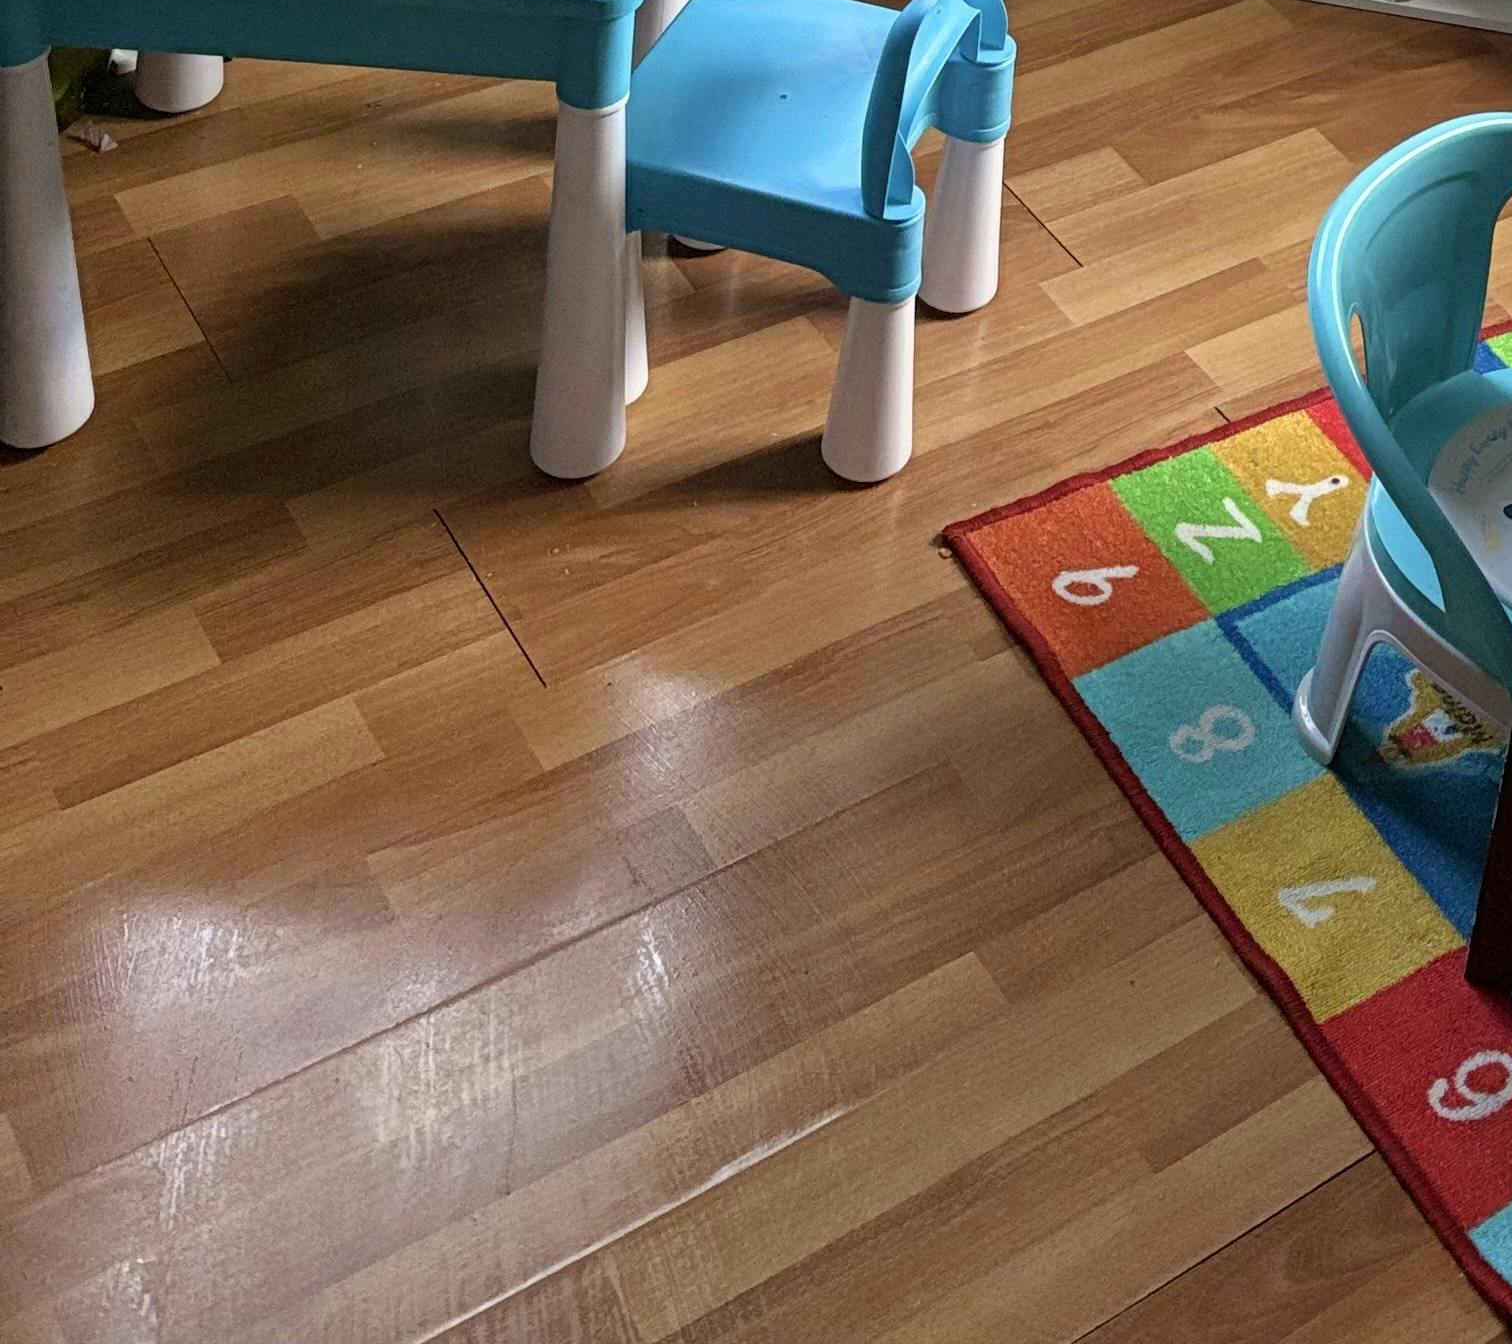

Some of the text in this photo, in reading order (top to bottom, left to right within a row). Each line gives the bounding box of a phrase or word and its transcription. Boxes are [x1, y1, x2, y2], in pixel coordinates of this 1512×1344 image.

[1265, 475, 1350, 527] Y
[1170, 705, 1257, 764] 8
[1277, 875, 1377, 928] 7
